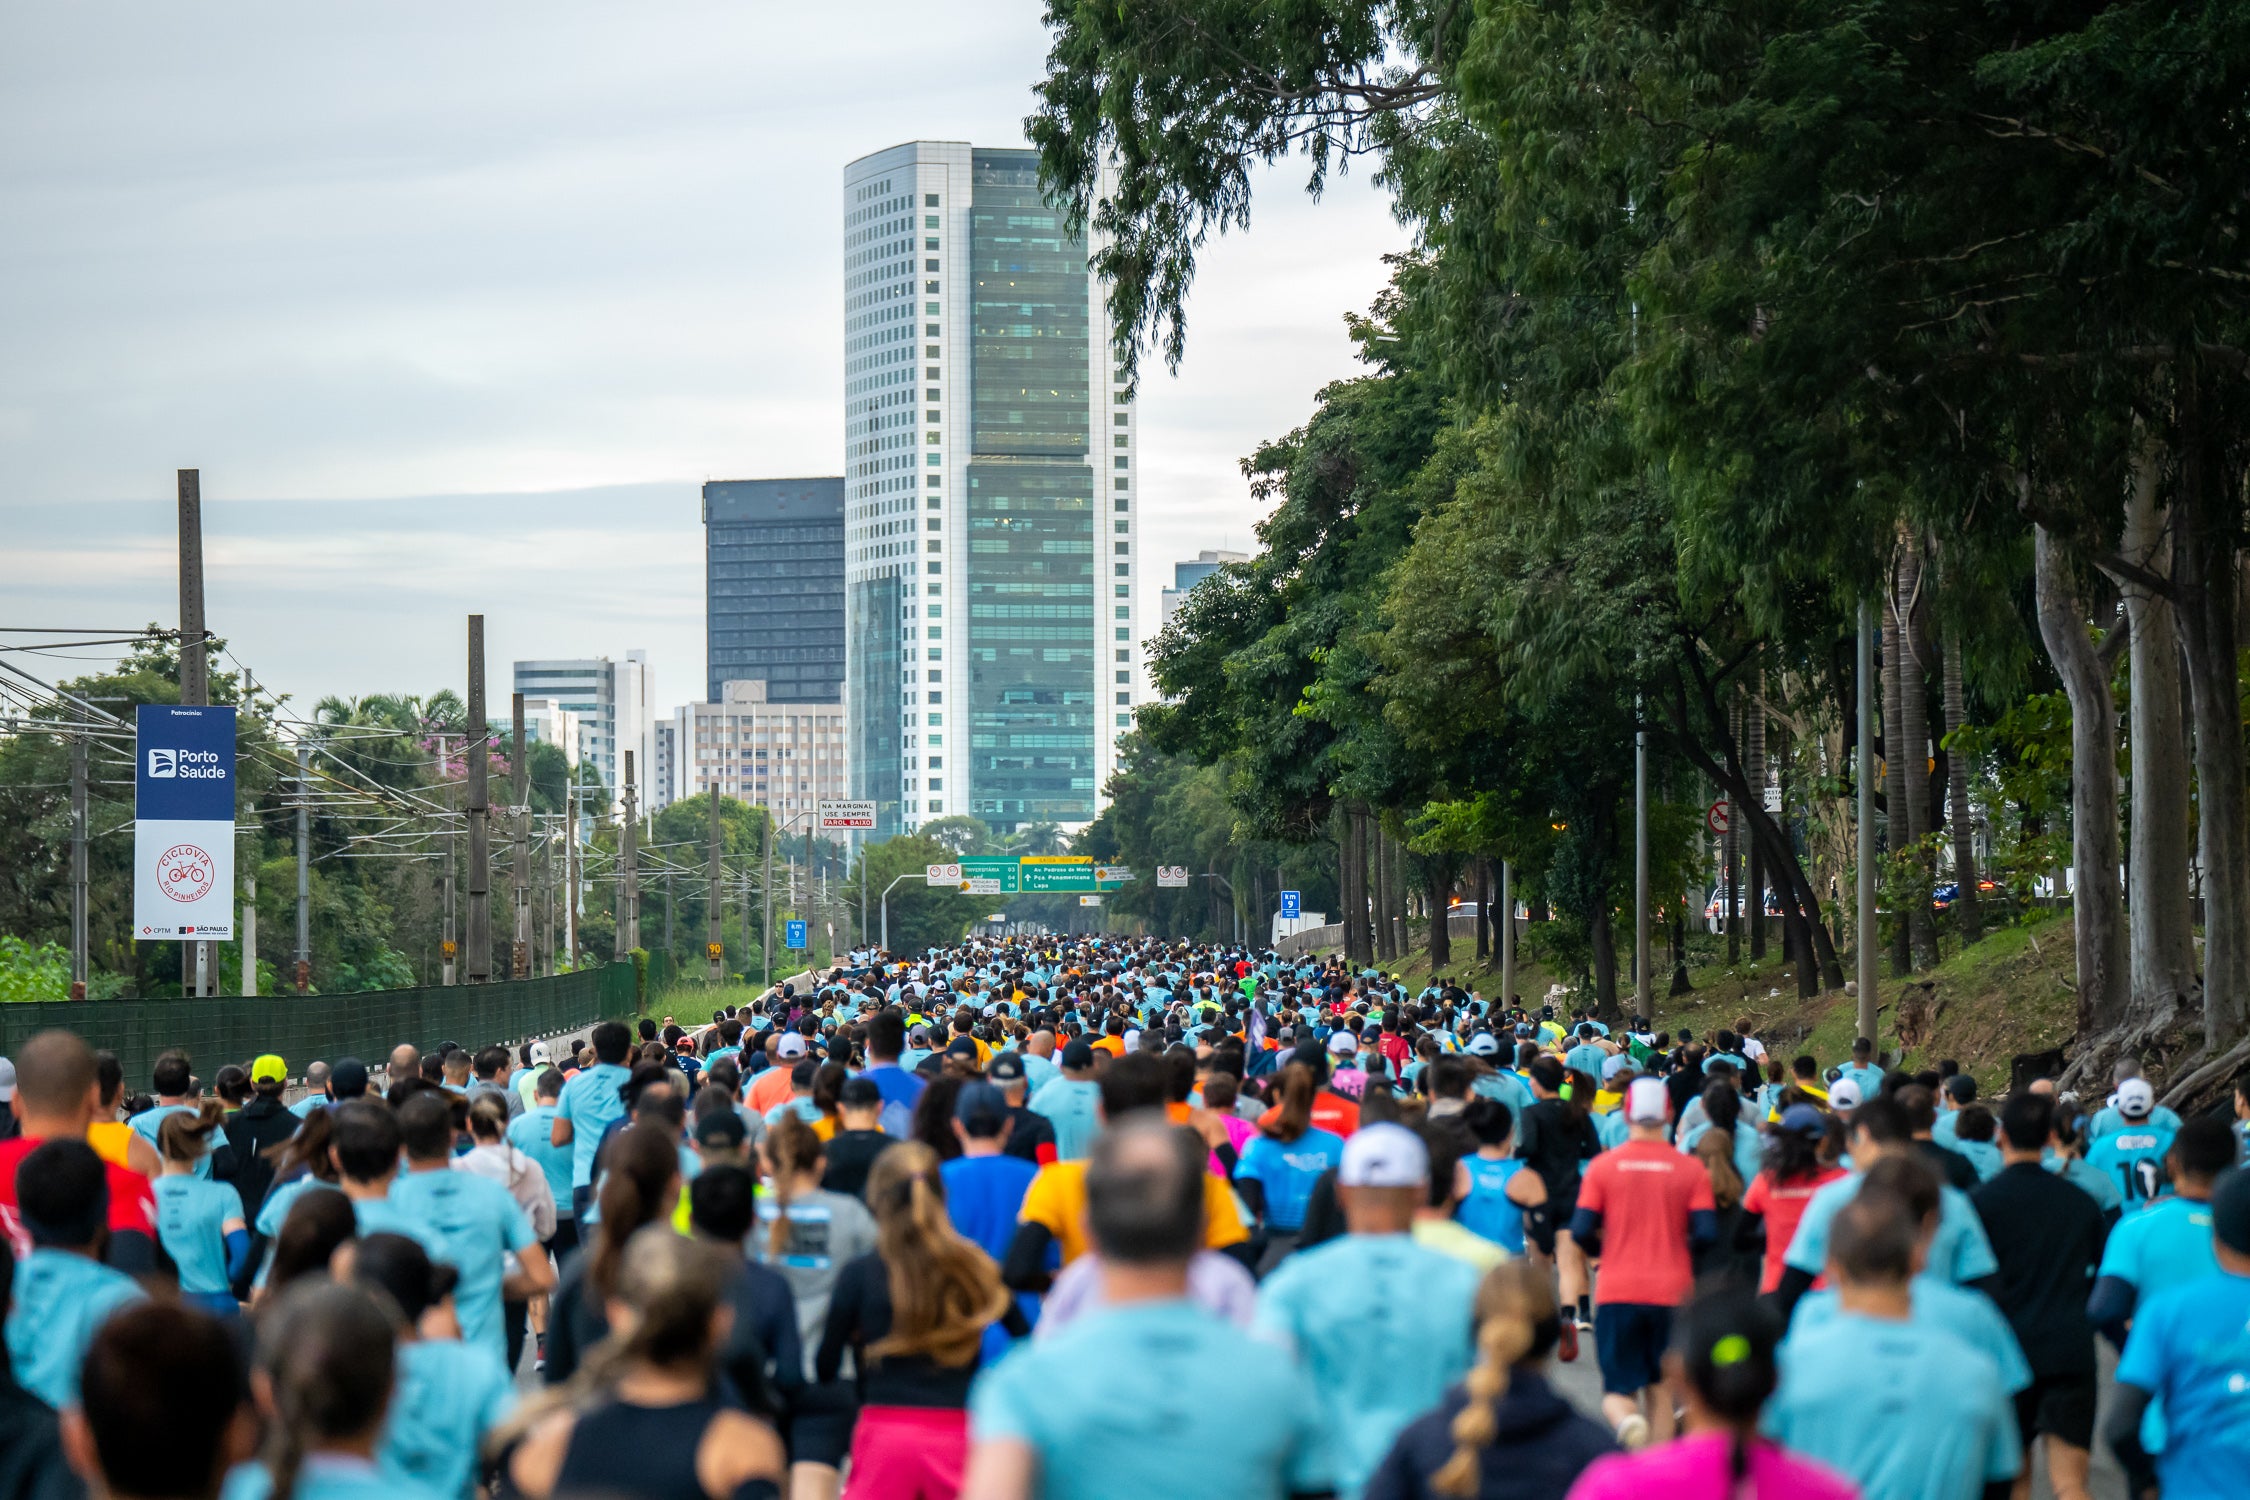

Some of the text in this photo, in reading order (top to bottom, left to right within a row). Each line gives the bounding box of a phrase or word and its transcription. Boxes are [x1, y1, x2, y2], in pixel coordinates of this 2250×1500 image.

[179, 749, 219, 763] Porto
[179, 765, 226, 779] Saúde
[162, 848, 209, 866] CICLOVIA
[163, 881, 209, 900] RIO PINHEIROS
[1288, 900, 1294, 908] 9
[709, 944, 721, 954] 90
